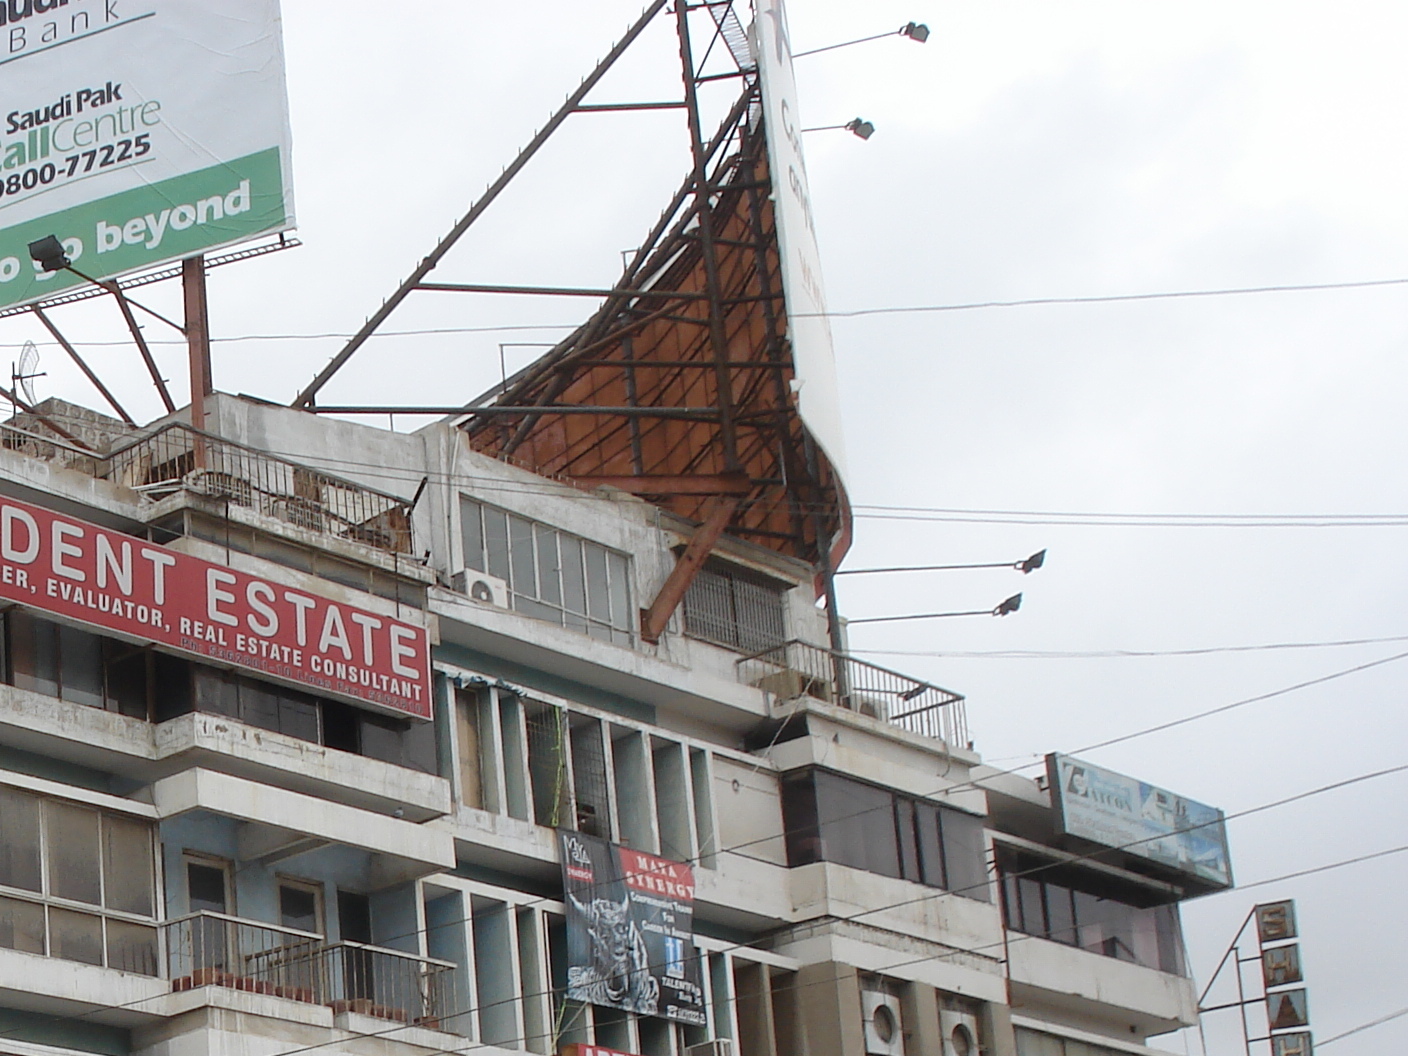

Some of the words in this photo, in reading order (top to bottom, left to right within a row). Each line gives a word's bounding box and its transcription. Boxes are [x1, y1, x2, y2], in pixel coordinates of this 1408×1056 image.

[9, 0, 121, 53] Bank
[6, 94, 73, 135] Saudi
[76, 81, 123, 113] Pak
[95, 180, 252, 255] beyond
[46, 578, 171, 633] EVALUATOR,
[179, 616, 228, 647] REAL
[236, 633, 303, 668] ESTATE
[310, 655, 423, 701] CONSULTANT
[206, 568, 421, 680] ESTATE
[625, 870, 695, 899] SYNERGY
[636, 855, 678, 879] MAYA
